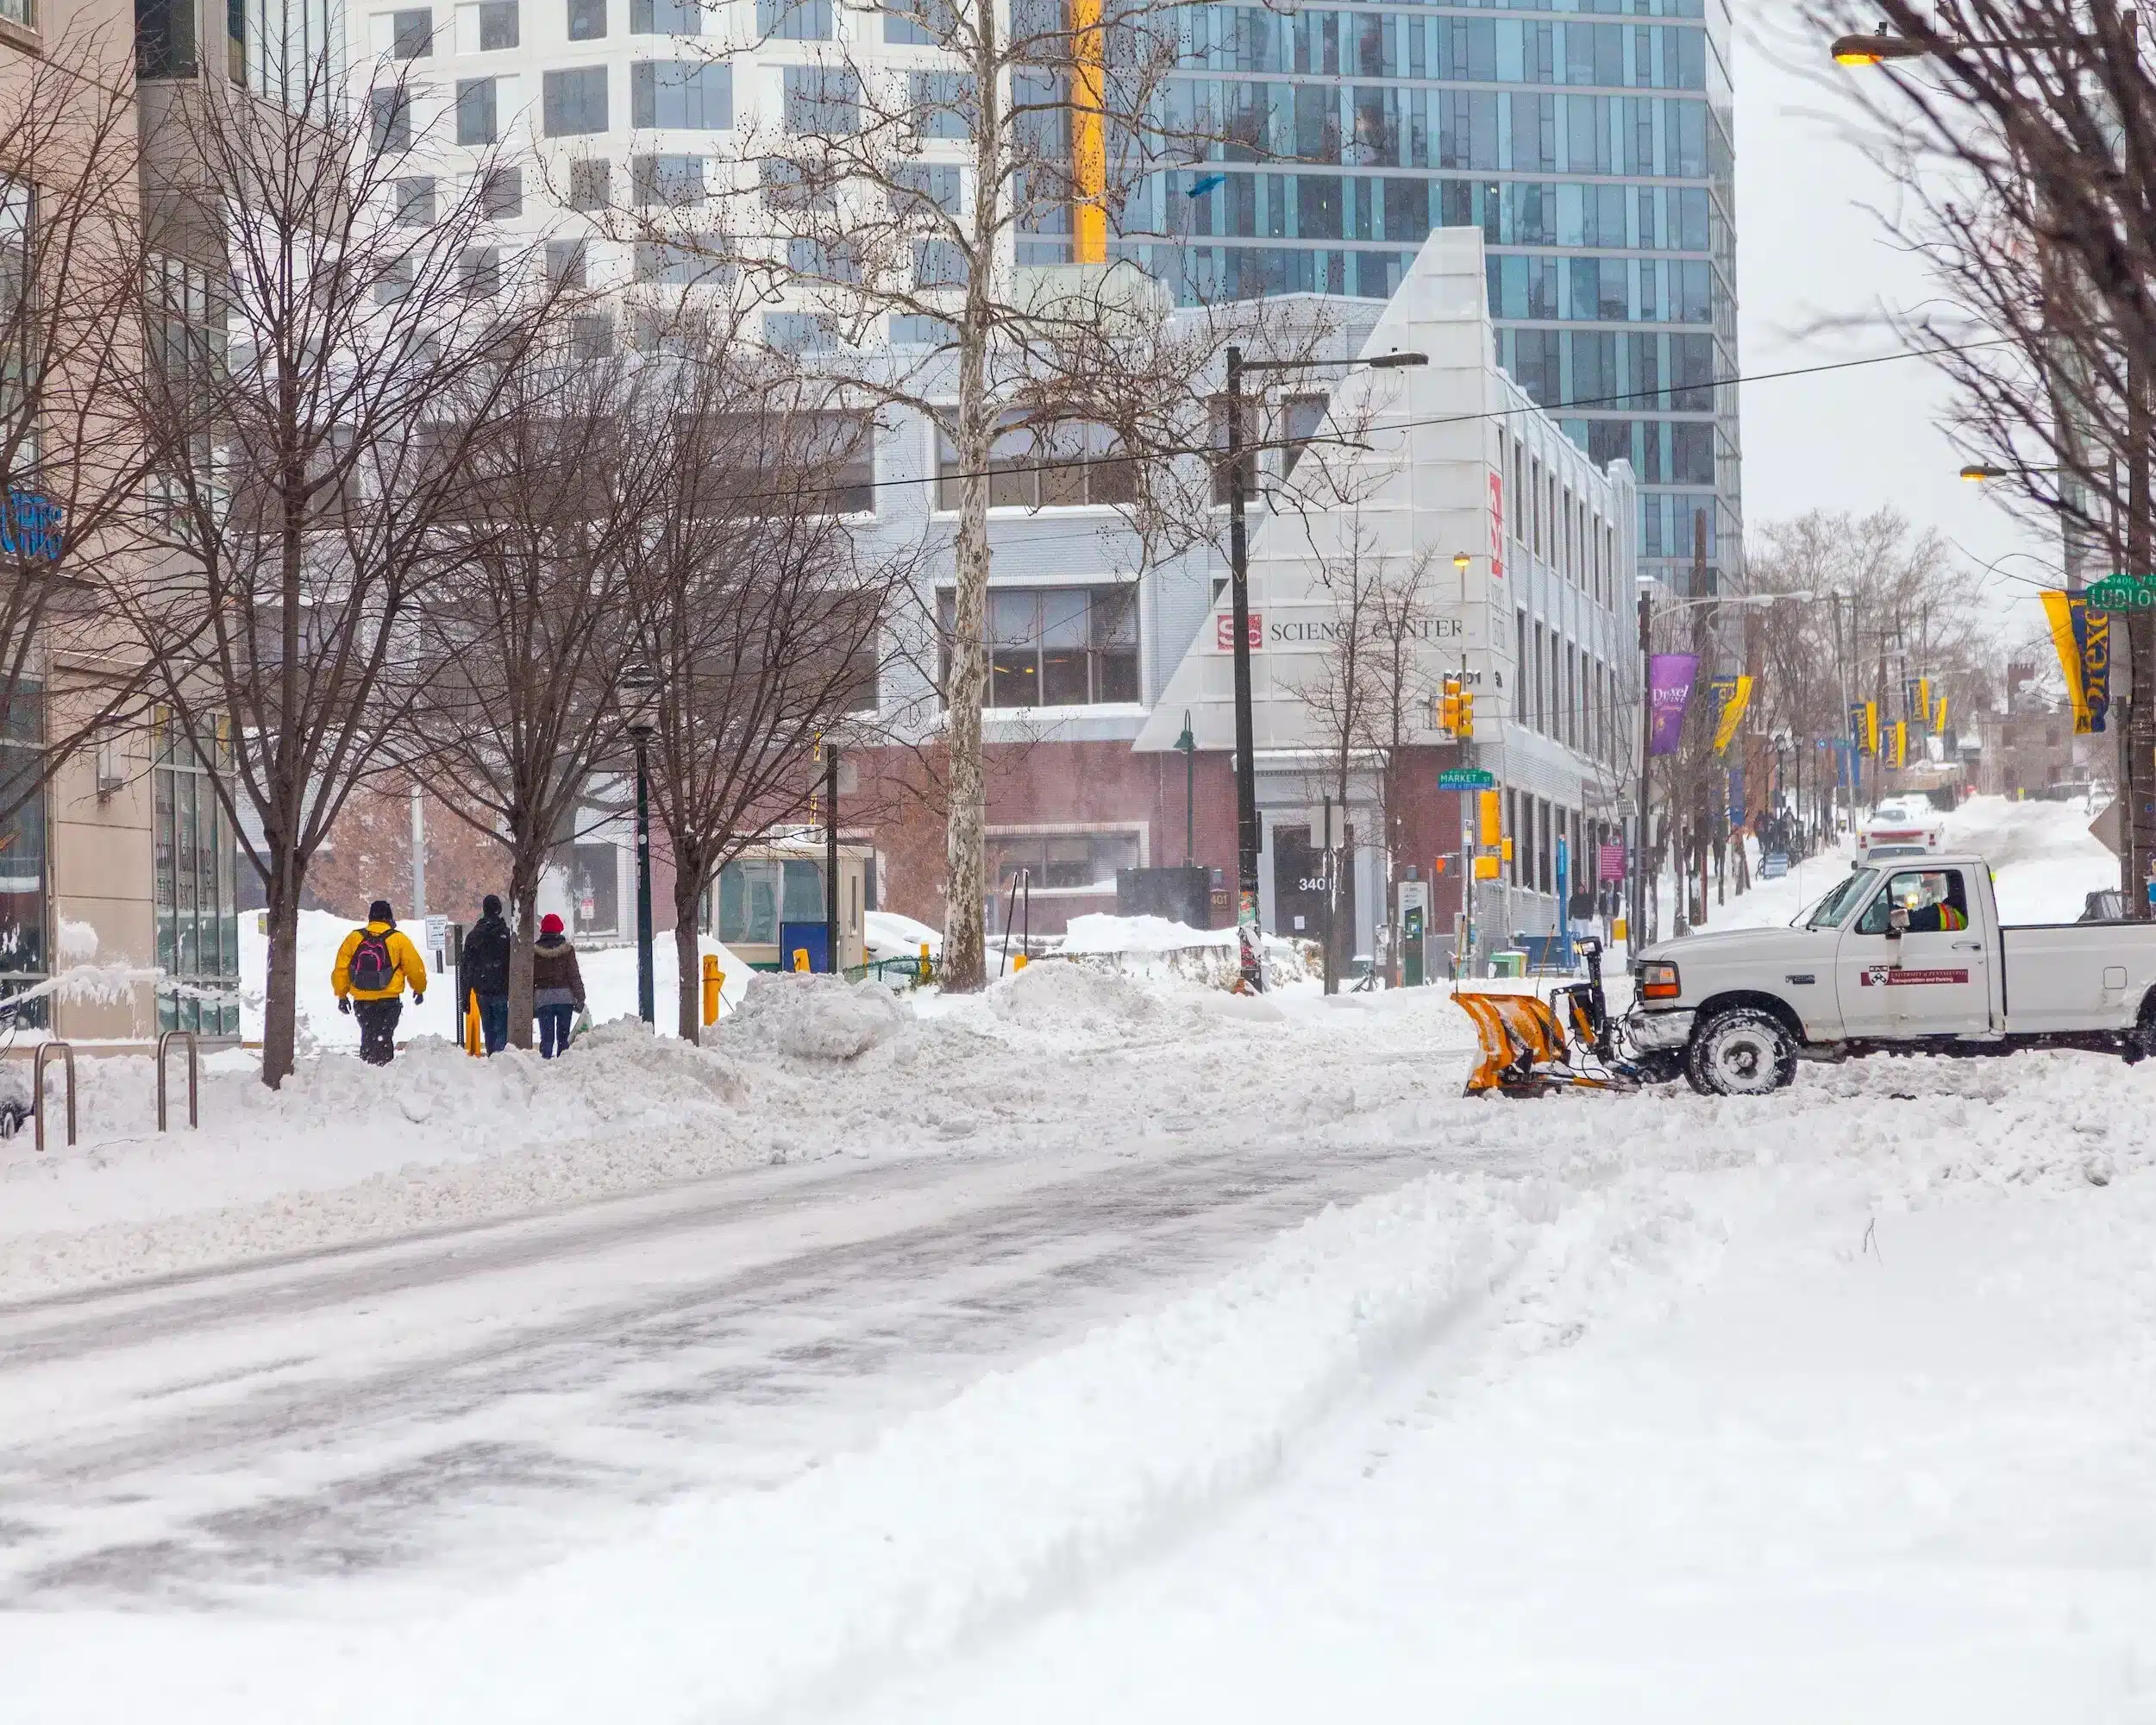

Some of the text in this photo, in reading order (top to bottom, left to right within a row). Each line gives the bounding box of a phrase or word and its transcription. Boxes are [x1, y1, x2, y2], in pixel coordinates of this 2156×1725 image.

[2091, 588, 2156, 608] LUDLO
[1271, 622, 1360, 641] SCIENCE
[1373, 619, 1463, 638] CENTER
[1299, 878, 1332, 891] 3401
